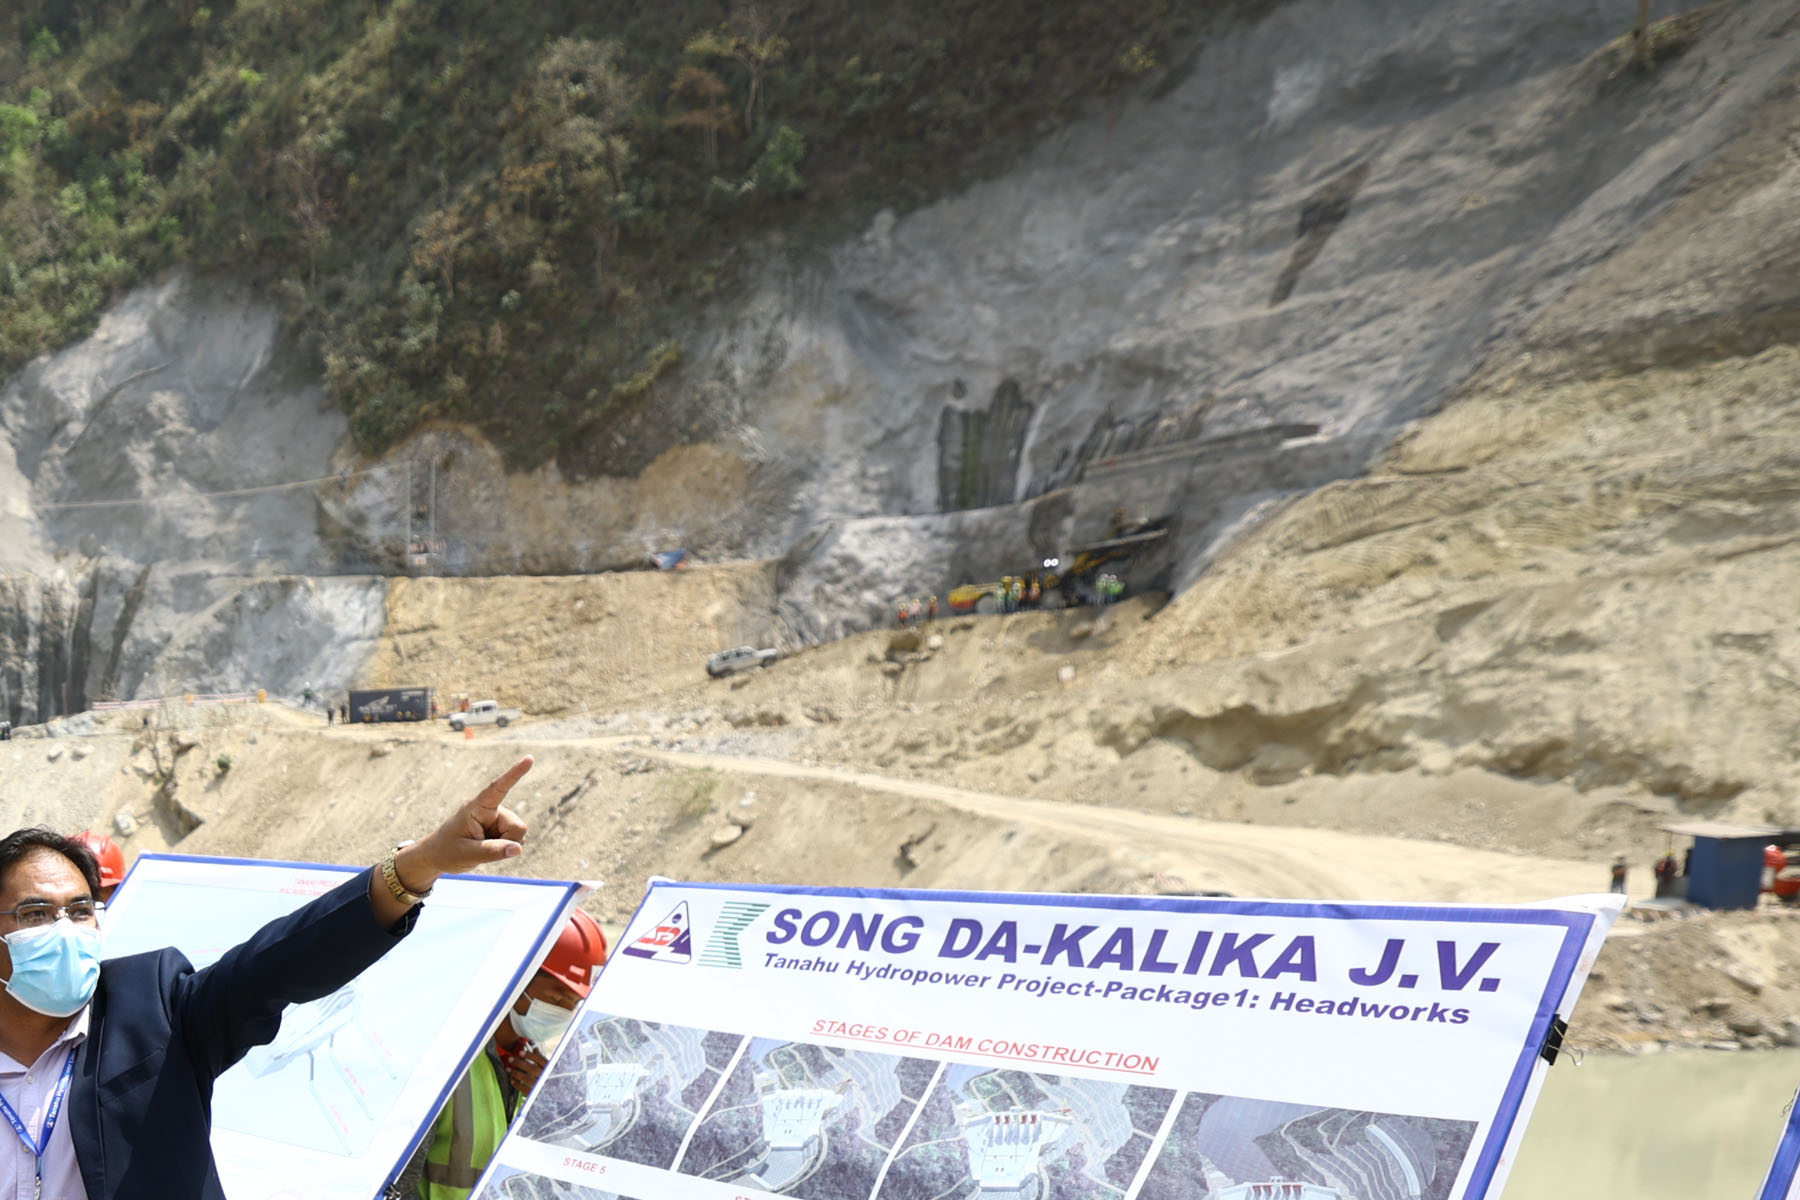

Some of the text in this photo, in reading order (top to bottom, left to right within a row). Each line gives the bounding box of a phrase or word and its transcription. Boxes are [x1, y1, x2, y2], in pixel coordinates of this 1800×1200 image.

[766, 908, 1502, 993] SONG DA-KALIKA J.V.
[764, 953, 1471, 1025] Tanahu Hydropower Project-Package1: Headworks
[813, 1019, 1160, 1073] STAGES OF DAM CONSTRUCTION
[563, 1157, 598, 1173] STAGE
